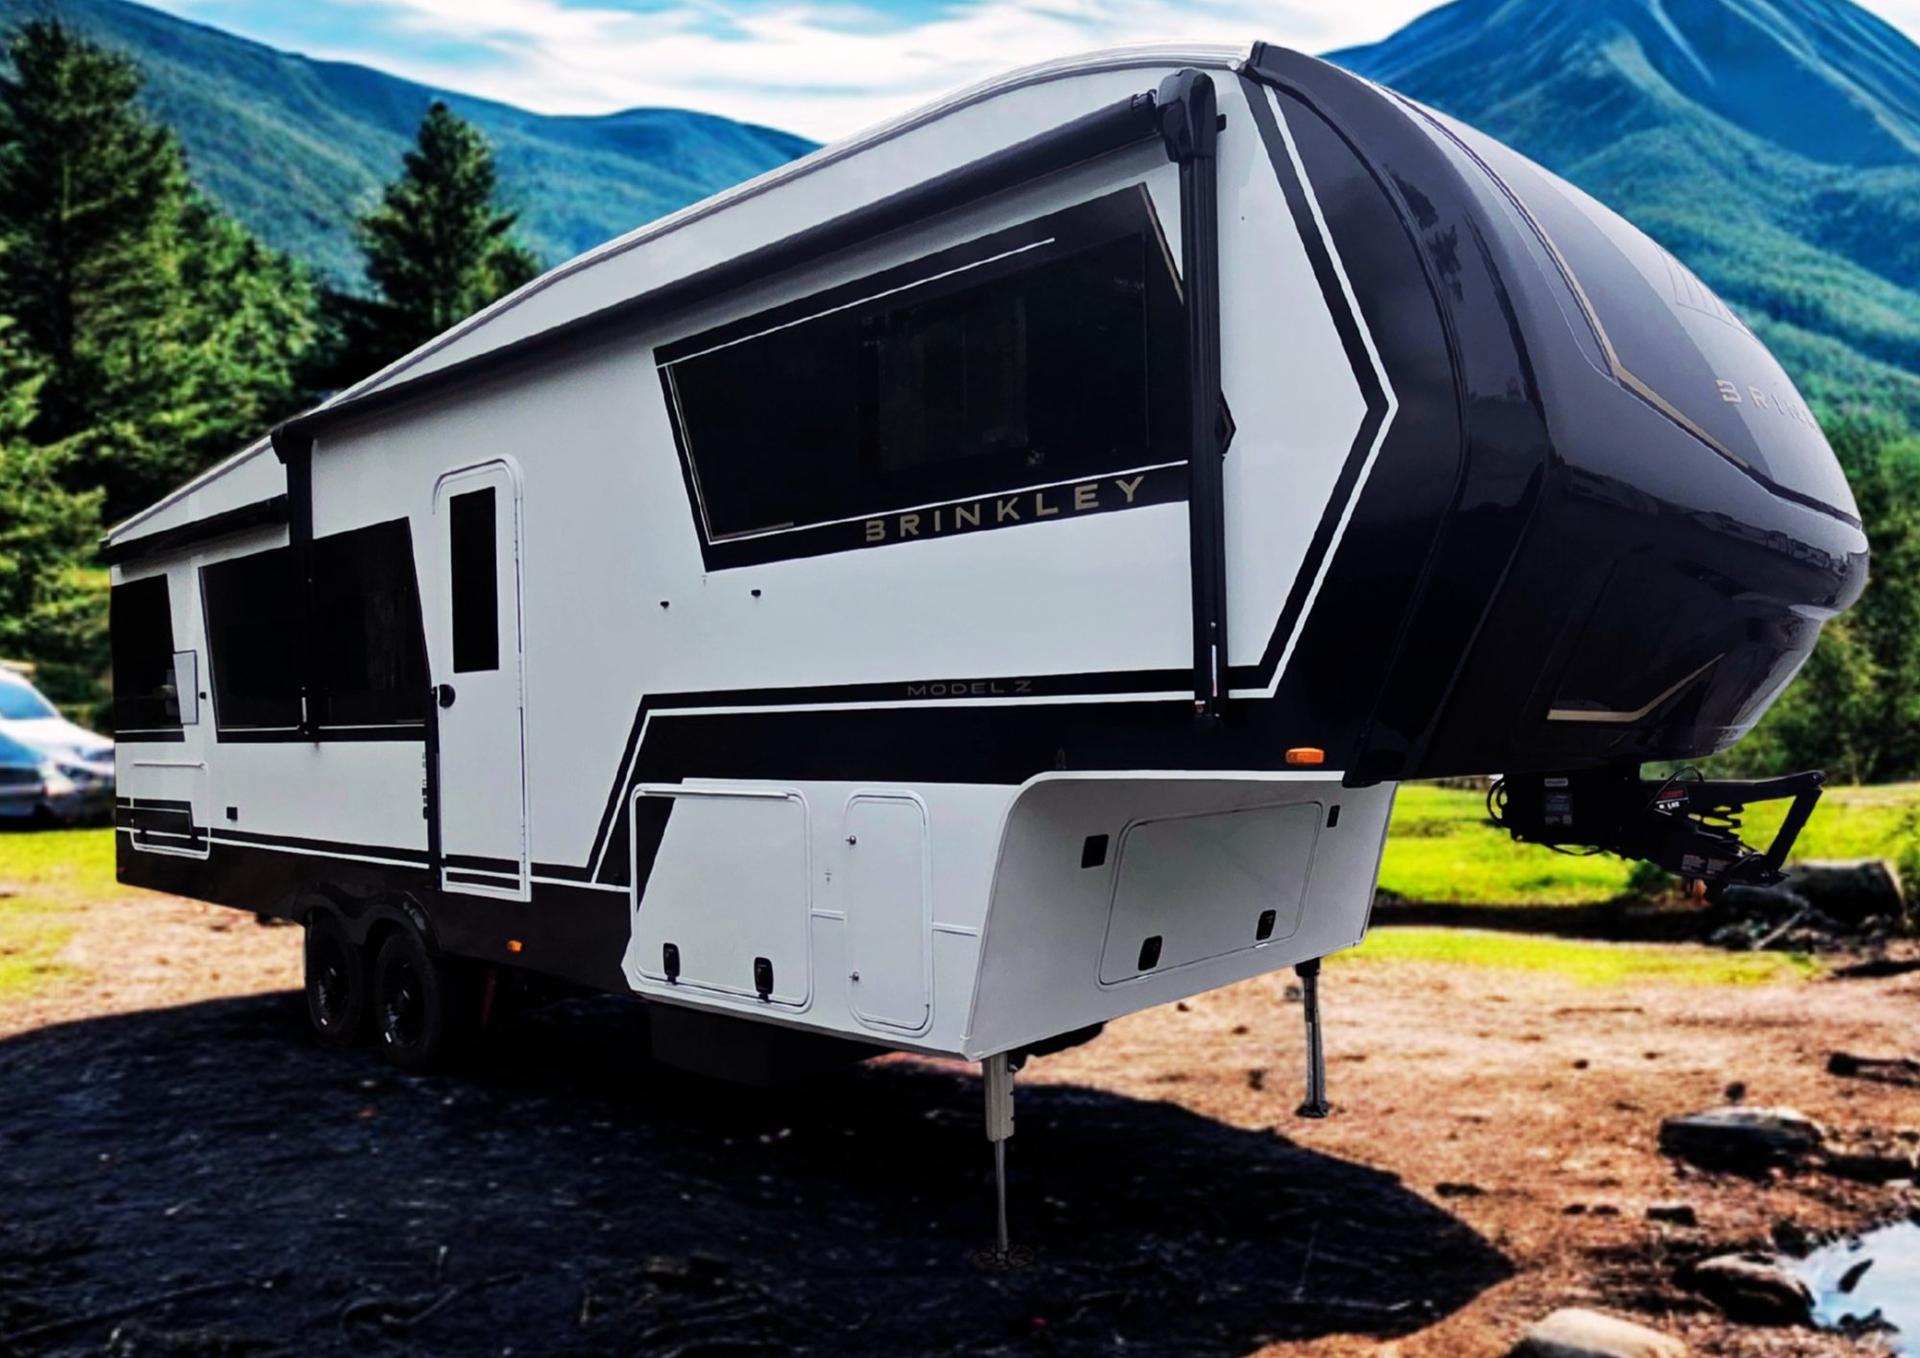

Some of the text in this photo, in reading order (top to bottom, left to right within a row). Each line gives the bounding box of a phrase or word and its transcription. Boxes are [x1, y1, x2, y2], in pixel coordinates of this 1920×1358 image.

[865, 475, 1144, 542] BRINKLEY
[906, 679, 1033, 697] MODEL Z
